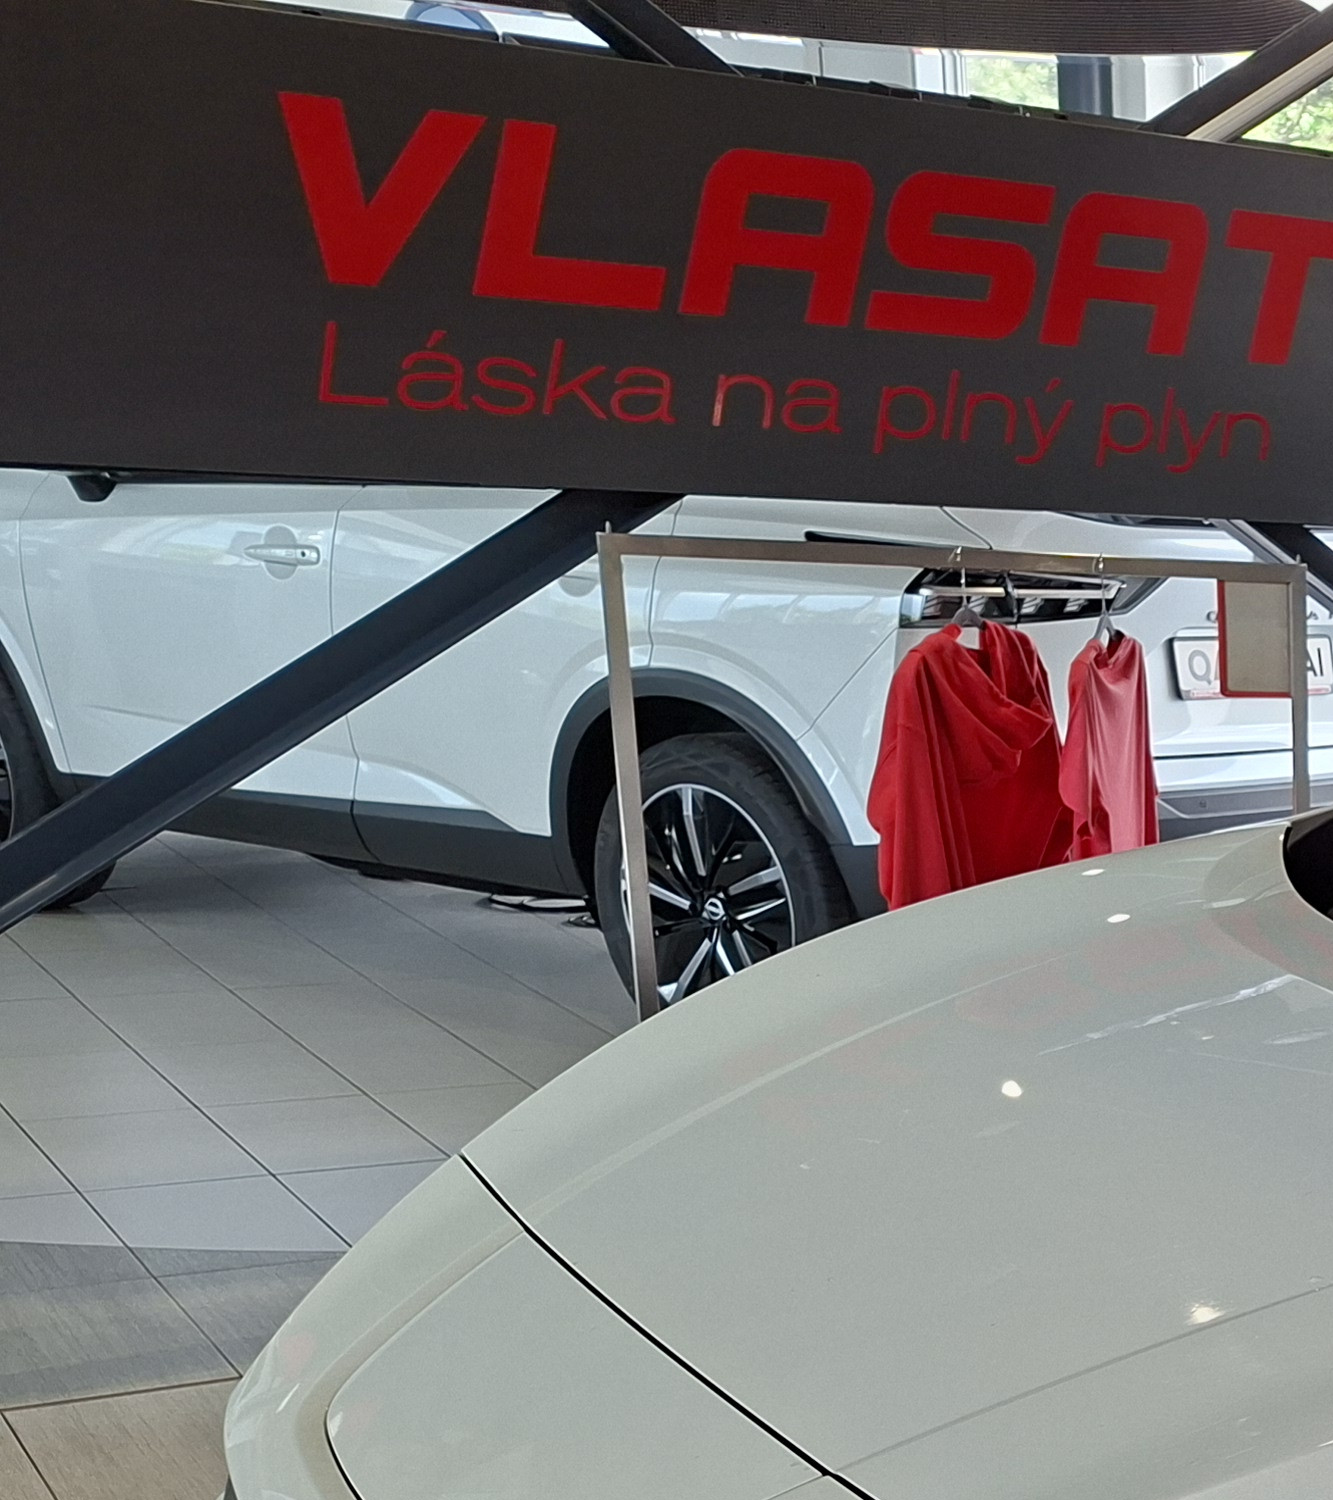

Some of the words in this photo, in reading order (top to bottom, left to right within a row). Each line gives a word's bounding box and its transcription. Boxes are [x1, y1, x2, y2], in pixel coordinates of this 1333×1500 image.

[317, 321, 678, 425] Láska
[712, 373, 843, 435] na
[873, 378, 1073, 465] plný
[1095, 387, 1272, 473] plyn
